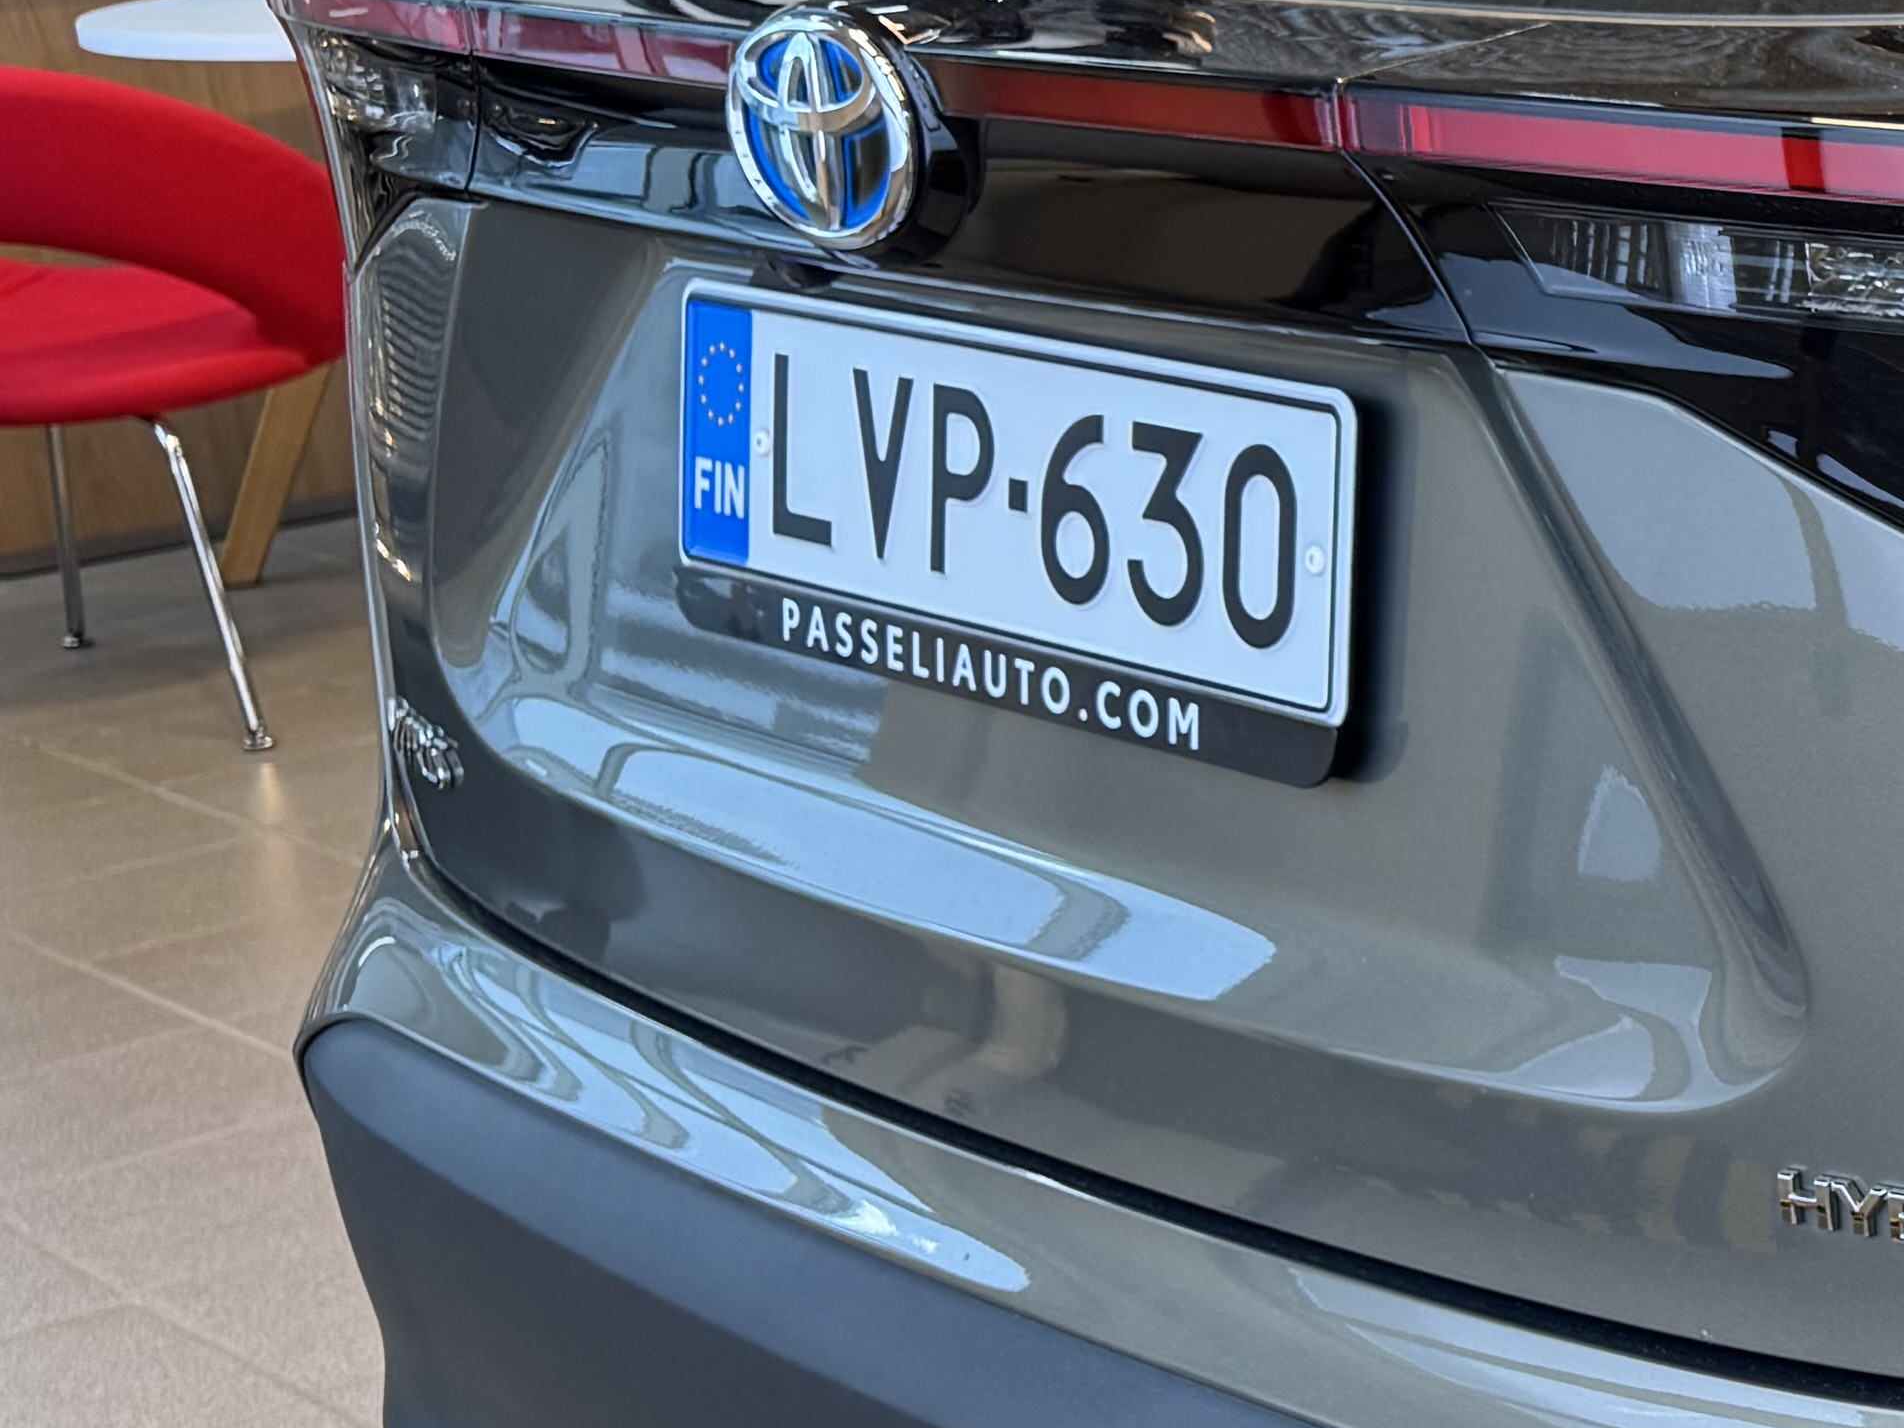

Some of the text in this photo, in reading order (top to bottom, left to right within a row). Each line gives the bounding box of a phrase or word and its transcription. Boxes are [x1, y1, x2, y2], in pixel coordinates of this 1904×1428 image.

[693, 457, 746, 520] FIN
[771, 352, 1298, 650] LVP-630
[781, 597, 1201, 752] PASSELIAUTO.COM
